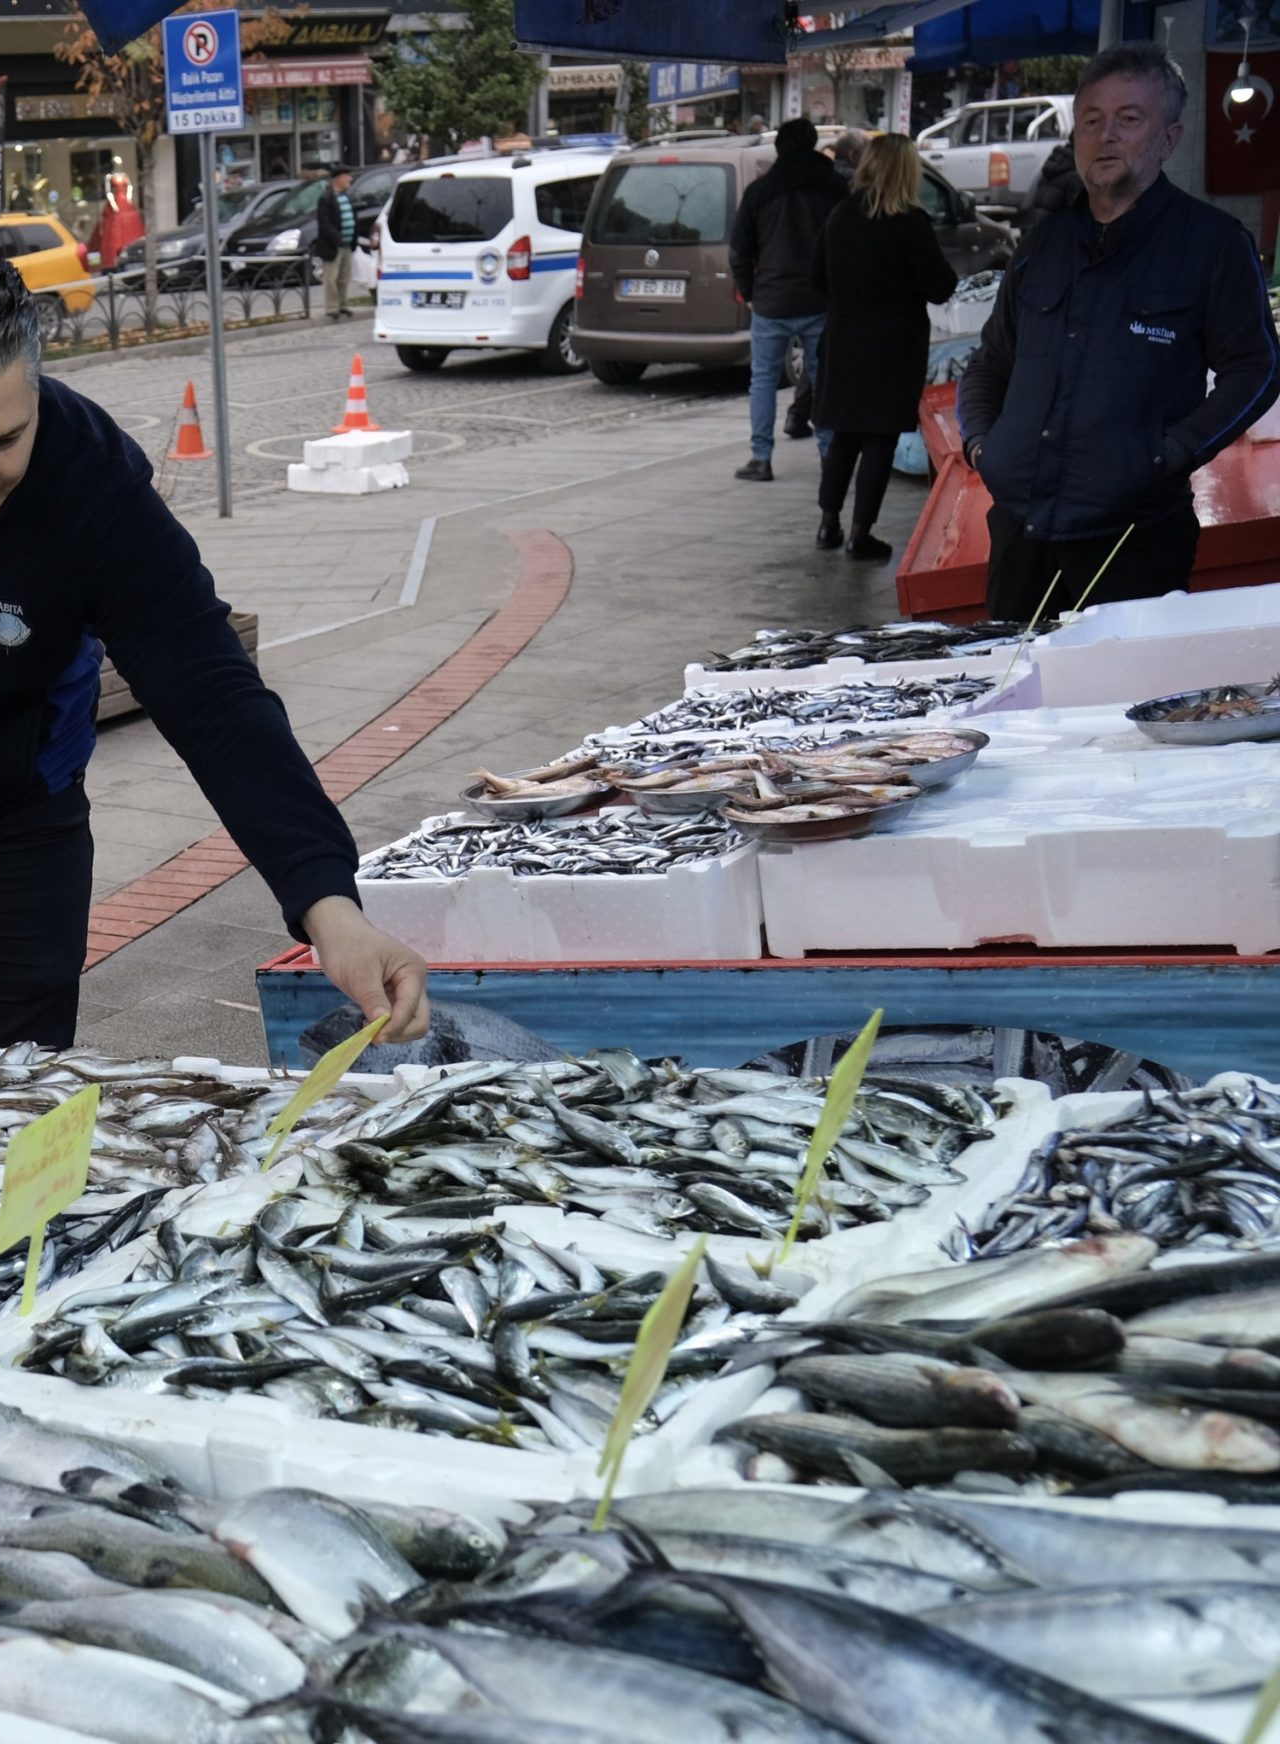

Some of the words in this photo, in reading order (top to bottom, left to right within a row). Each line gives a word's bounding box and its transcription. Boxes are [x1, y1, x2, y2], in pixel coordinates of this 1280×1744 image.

[292, 23, 385, 45] AMBALAJ
[551, 71, 620, 87] UMBASA
[174, 113, 189, 127] 15
[193, 111, 236, 127] Dakika
